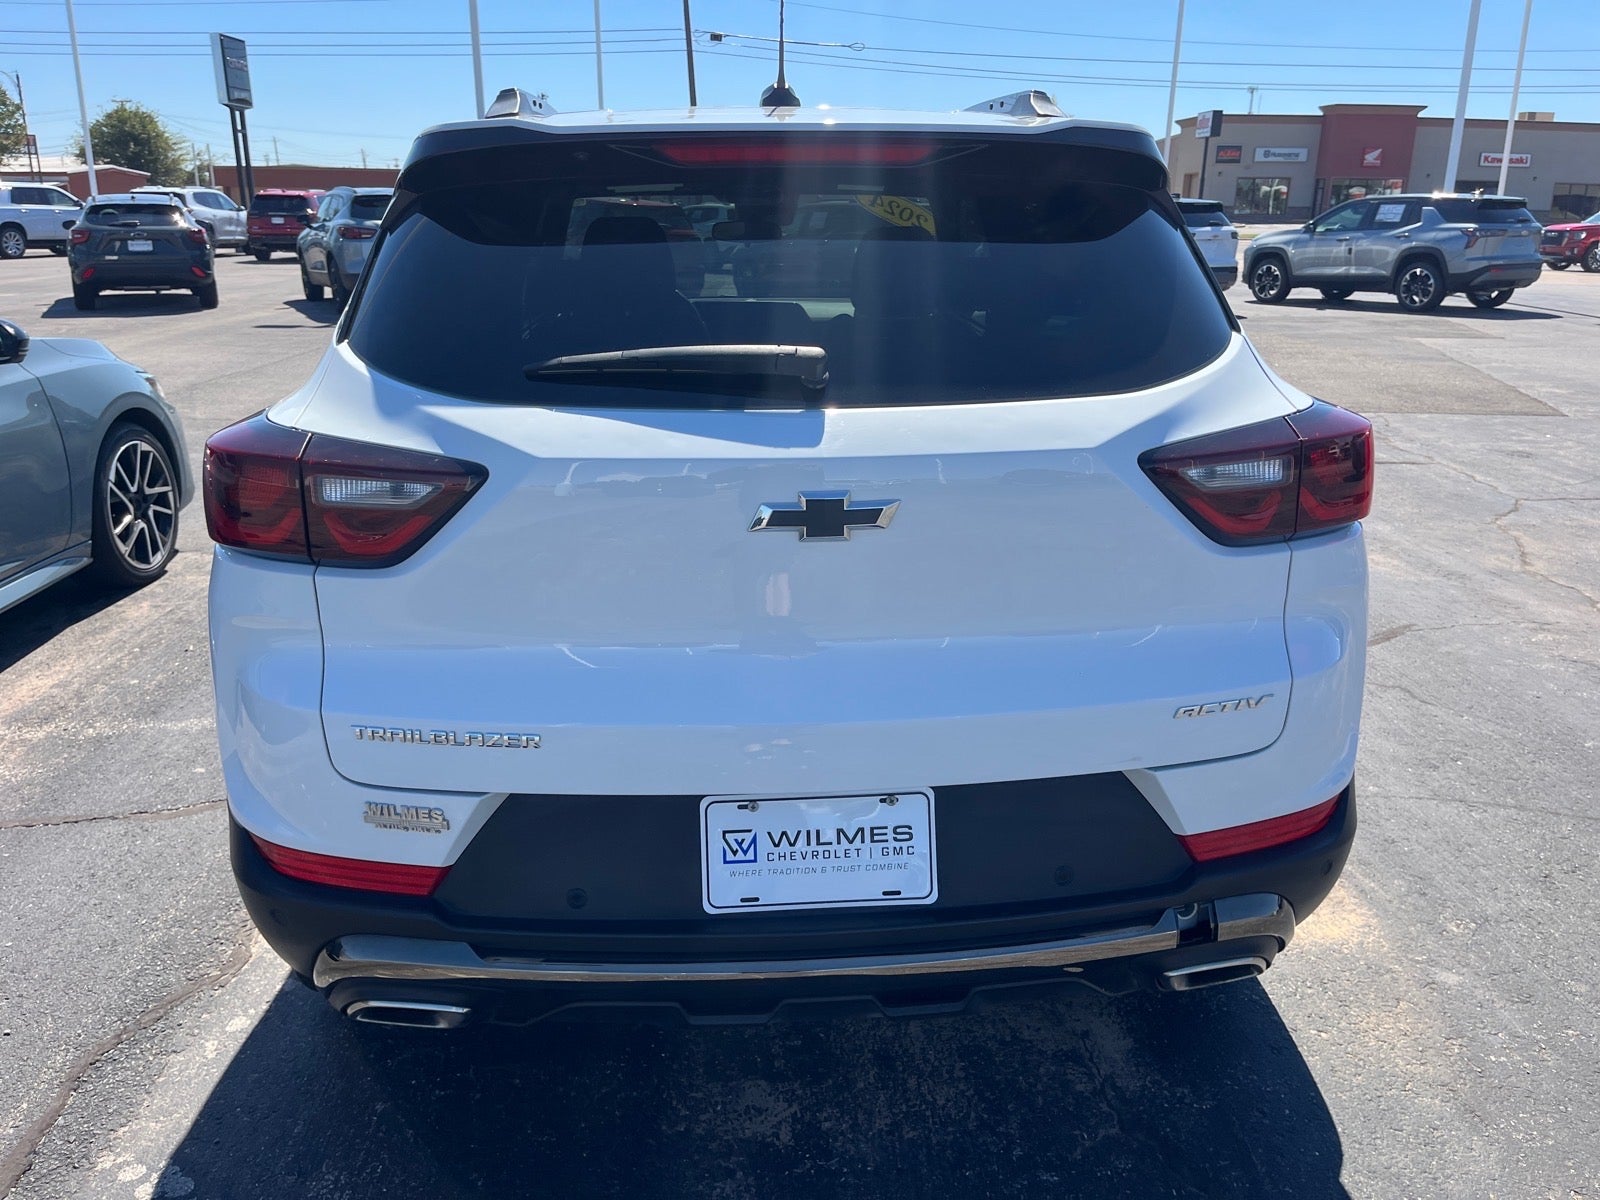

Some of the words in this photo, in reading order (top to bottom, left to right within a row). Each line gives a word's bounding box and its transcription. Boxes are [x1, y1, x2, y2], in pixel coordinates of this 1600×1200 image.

[1483, 154, 1528, 165] Kawsaki
[1173, 693, 1274, 720] ACTIV
[350, 724, 542, 749] TRAILBLAZER
[363, 801, 446, 824] WILMES
[766, 825, 914, 848] WILMES
[766, 847, 862, 862] CHEVROLET
[881, 845, 915, 857] GMC
[729, 868, 763, 878] WHERE
[767, 866, 818, 876] TRADITION
[831, 864, 862, 873] TRUST
[865, 862, 909, 871] COMBINE
